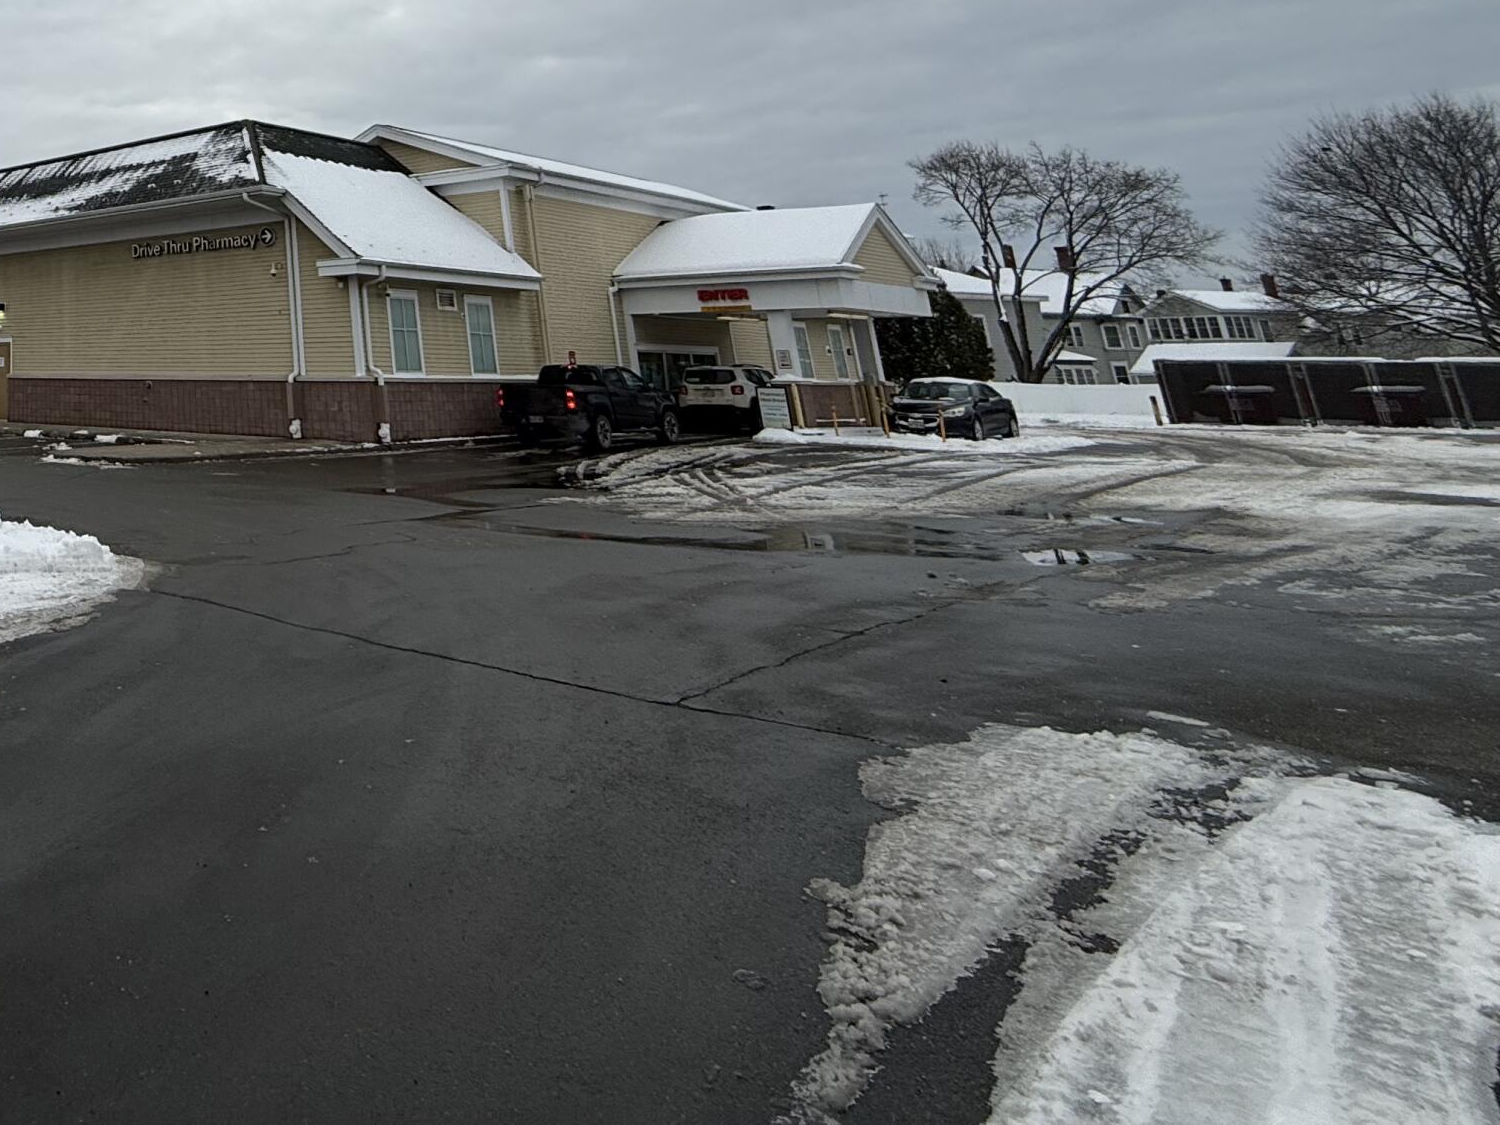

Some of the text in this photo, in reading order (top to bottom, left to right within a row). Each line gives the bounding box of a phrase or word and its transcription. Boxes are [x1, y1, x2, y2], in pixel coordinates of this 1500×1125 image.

[131, 234, 257, 259] Drive Thru Pharmacy
